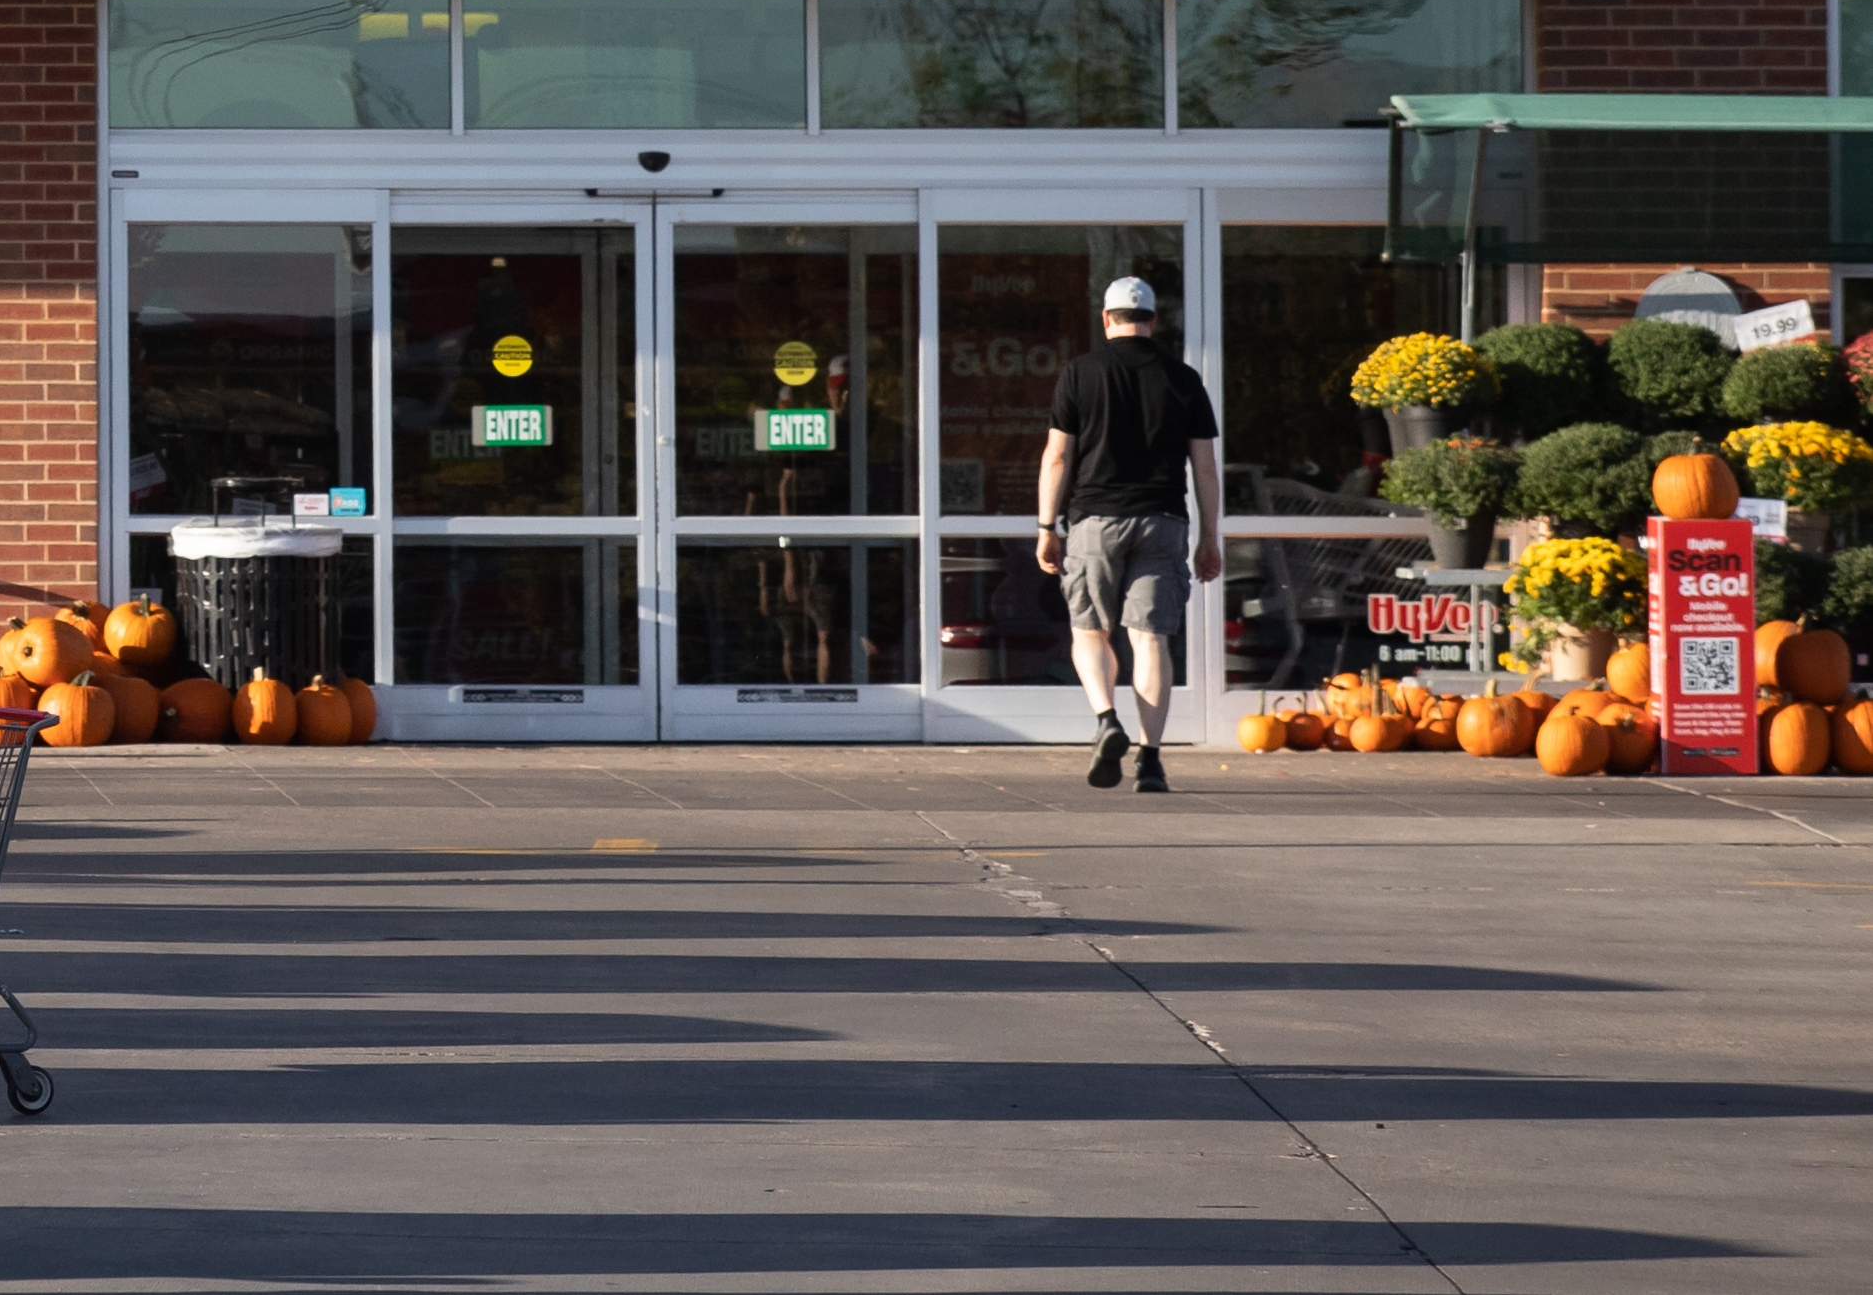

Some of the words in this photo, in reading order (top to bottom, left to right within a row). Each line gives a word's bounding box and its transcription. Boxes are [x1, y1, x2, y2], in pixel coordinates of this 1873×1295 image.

[1751, 316, 1797, 339] 19.99
[486, 410, 542, 441] ENTER
[769, 414, 827, 445] ENTER
[696, 428, 767, 456] ENTE
[1668, 550, 1741, 572] Scan
[1679, 573, 1750, 598] &Go!
